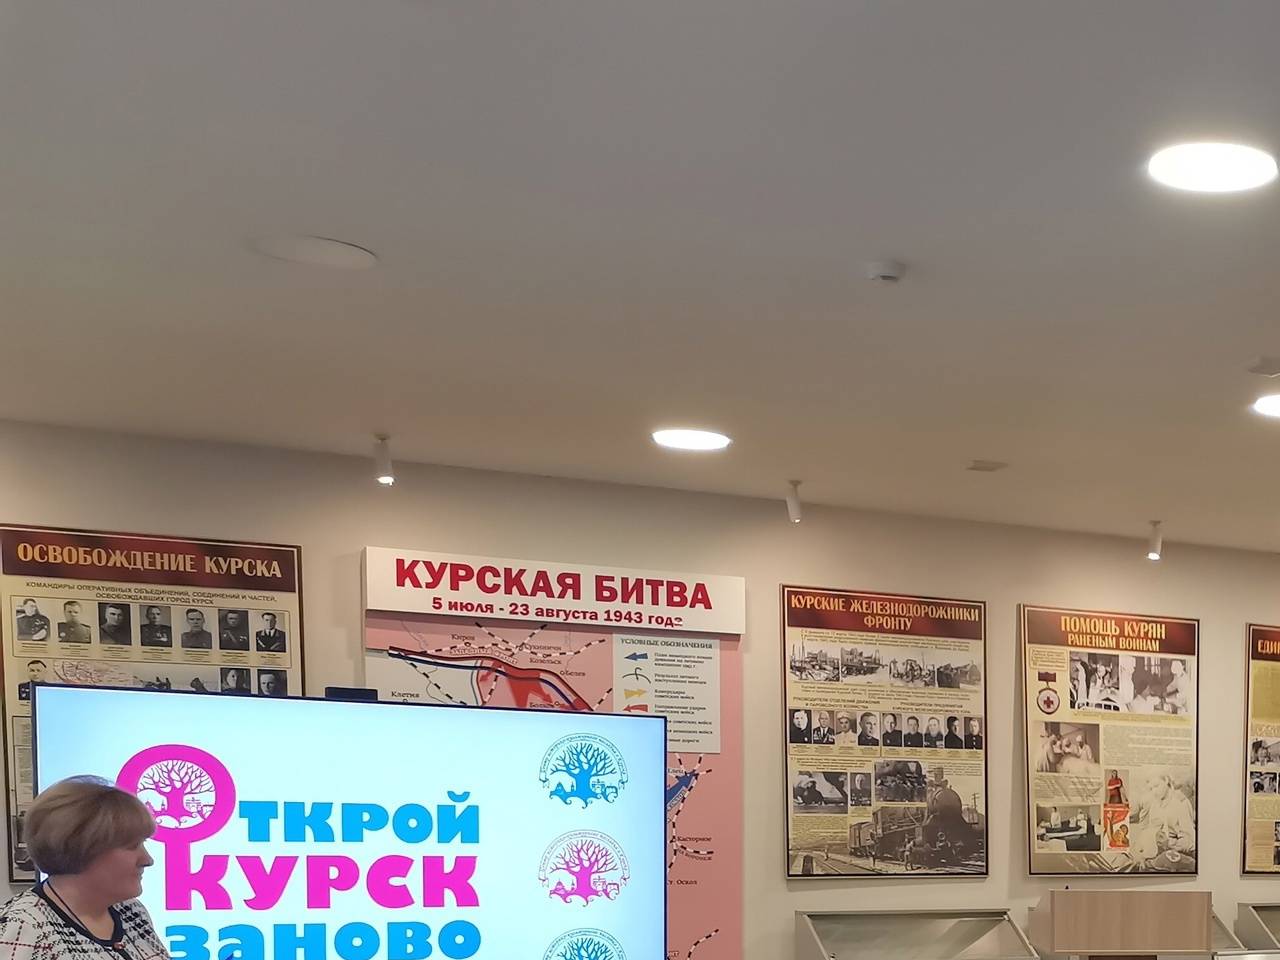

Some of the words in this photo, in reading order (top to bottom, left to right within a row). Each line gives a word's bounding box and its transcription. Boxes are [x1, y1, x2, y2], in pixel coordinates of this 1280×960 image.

[17, 542, 198, 574] ОСВОБОЖДЕНИЕ
[204, 556, 283, 579] КУРСКА
[26, 581, 75, 590] КОМАНДИРЫ
[77, 584, 132, 594] ОПЕРАТИВНЫХ
[395, 557, 582, 601] КУРСКАЯ
[594, 575, 714, 610] БИТВА
[432, 597, 443, 611] 5
[448, 600, 495, 614] июля
[508, 603, 530, 616] 23
[535, 607, 598, 622] августа
[603, 609, 643, 624] 1943
[791, 594, 847, 612] КУРСКИЕ
[849, 599, 979, 622] ЖЕЛЕЗНОДОРОЖНИКИ
[863, 615, 913, 631] ФРОНТУ
[1060, 615, 1120, 636] ПОМОЩЬ
[1124, 620, 1166, 640] КУРЯН
[1067, 633, 1116, 649] РАНЕНЫМ
[1119, 637, 1160, 652] ВОИНАМ
[164, 854, 480, 911] КУРСК
